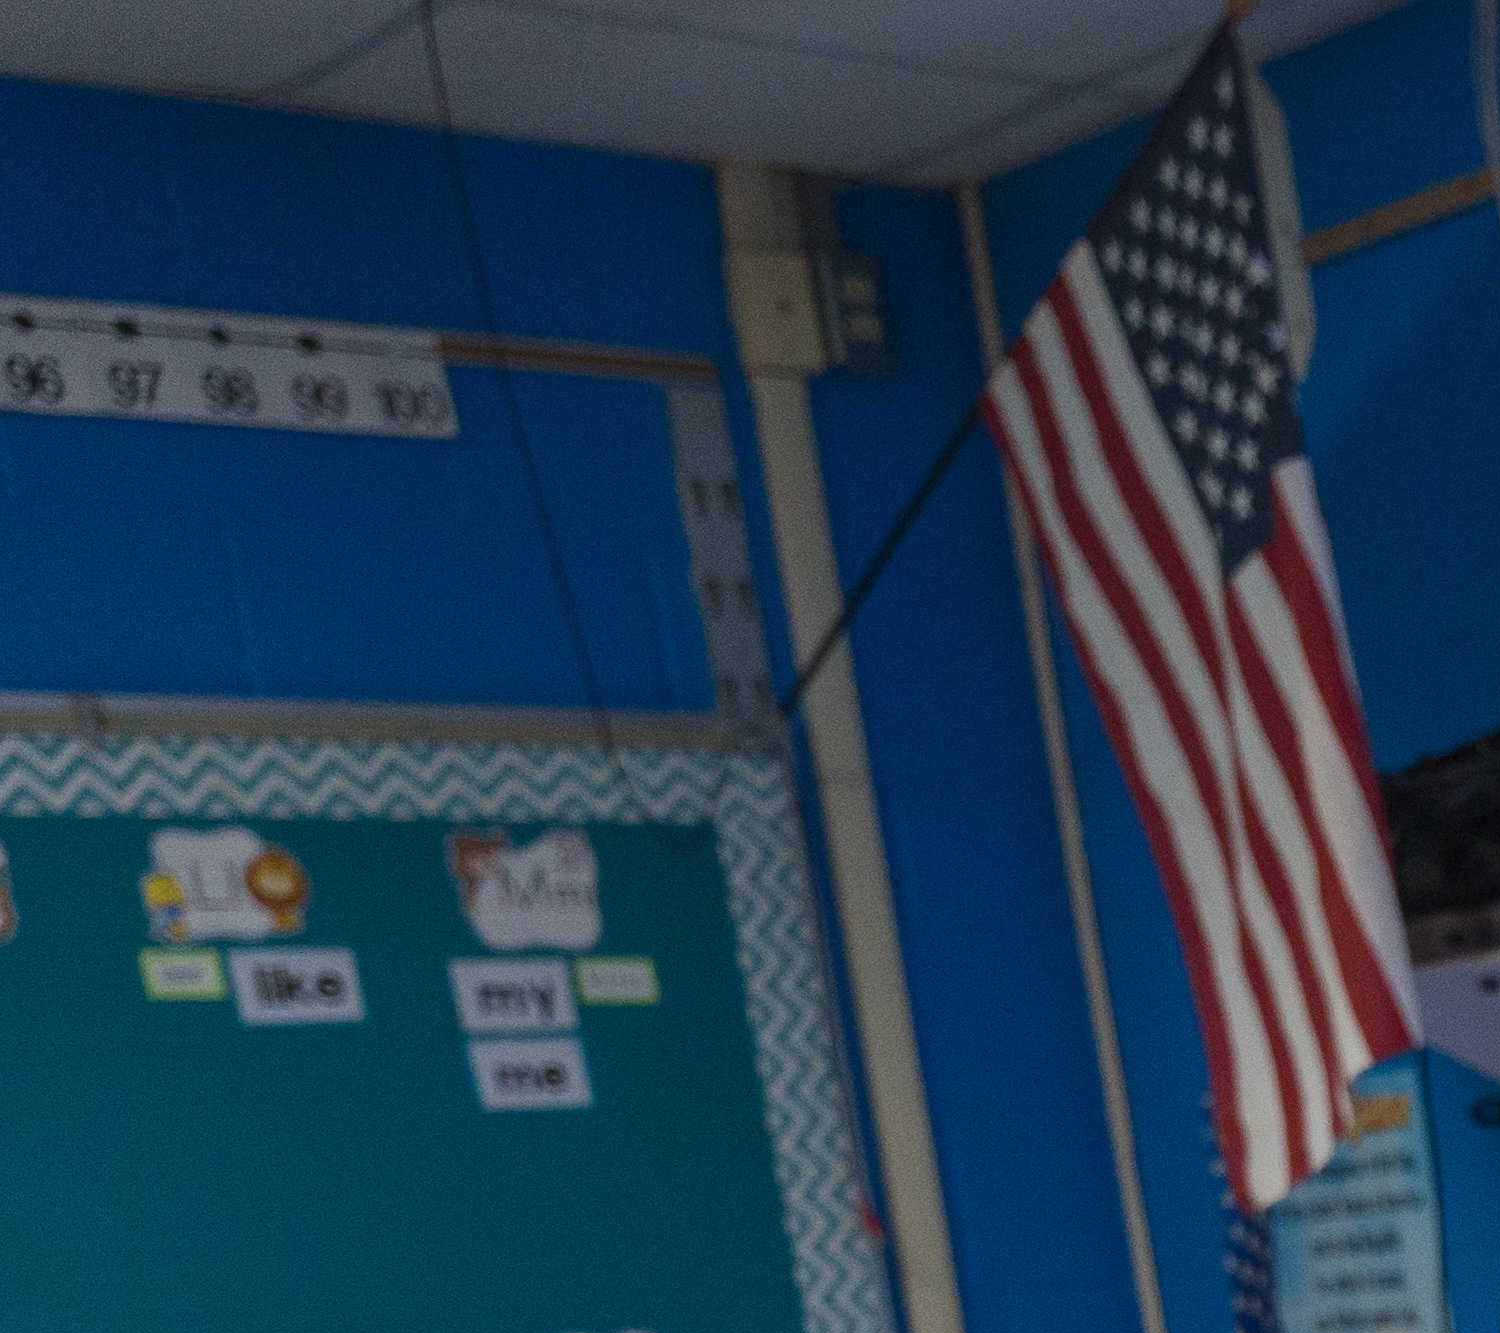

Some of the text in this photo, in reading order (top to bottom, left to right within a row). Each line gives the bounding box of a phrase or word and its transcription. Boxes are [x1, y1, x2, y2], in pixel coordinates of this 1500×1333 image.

[4, 352, 450, 428] 96 97 98 99 100
[254, 962, 345, 1006] like
[476, 978, 557, 1023] my
[494, 1057, 568, 1092] me
